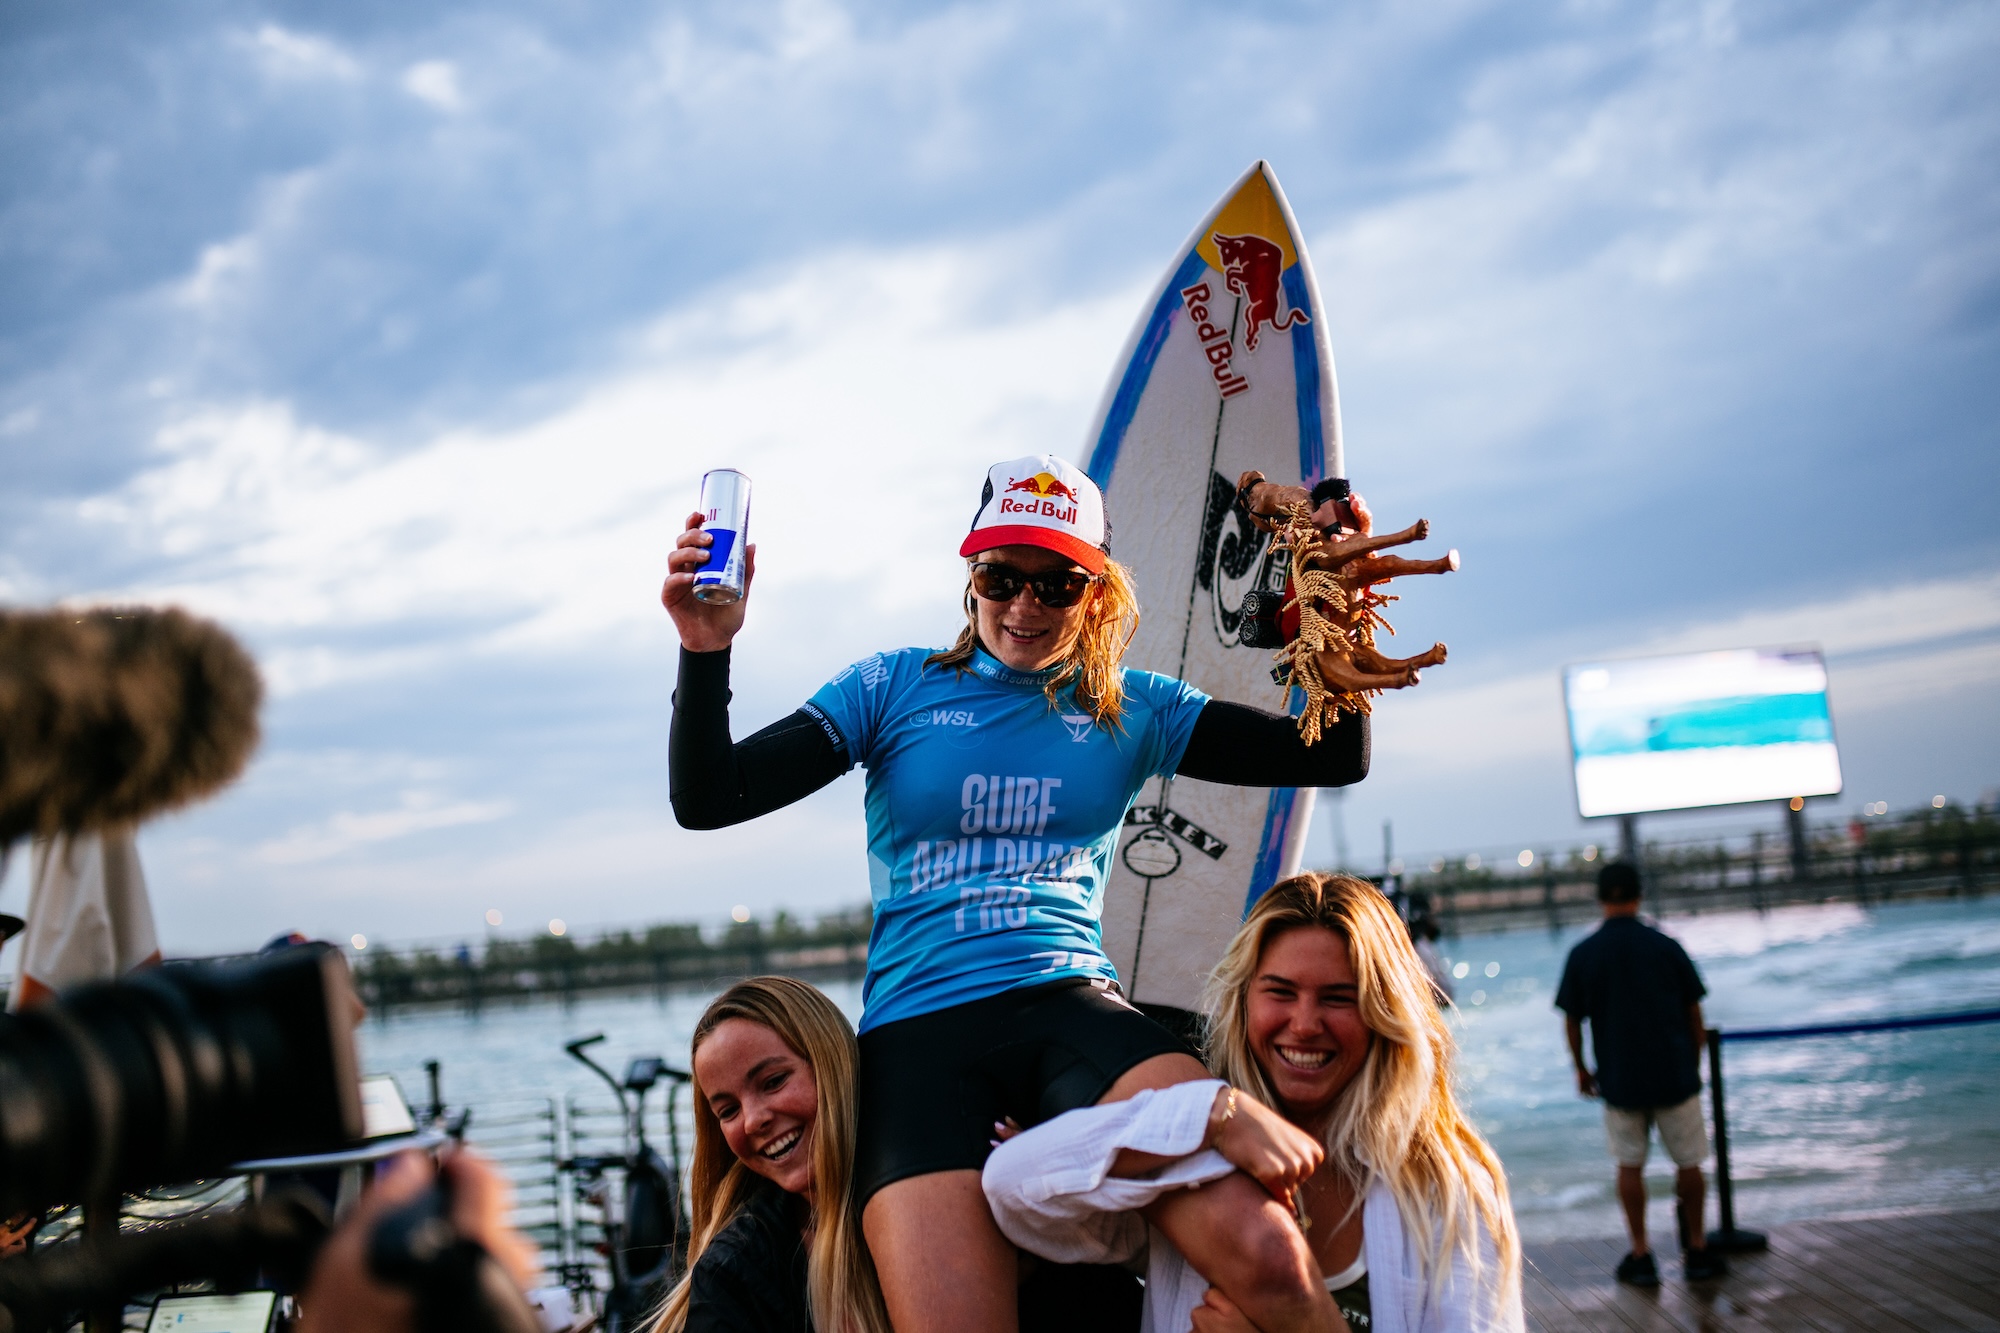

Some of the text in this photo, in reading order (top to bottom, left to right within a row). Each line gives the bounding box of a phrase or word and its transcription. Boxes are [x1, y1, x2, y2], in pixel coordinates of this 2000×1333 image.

[1182, 283, 1249, 398] Red Bull
[1000, 498, 1079, 525] Red Bull
[976, 660, 1009, 680] WORLD
[1009, 675, 1036, 686] SURF
[820, 718, 840, 745] TOUR
[932, 710, 979, 727] WSL
[959, 773, 1062, 837] SURF
[1133, 807, 1220, 851] KLEY
[909, 837, 983, 895] ABU
[955, 885, 1032, 932] PRO
